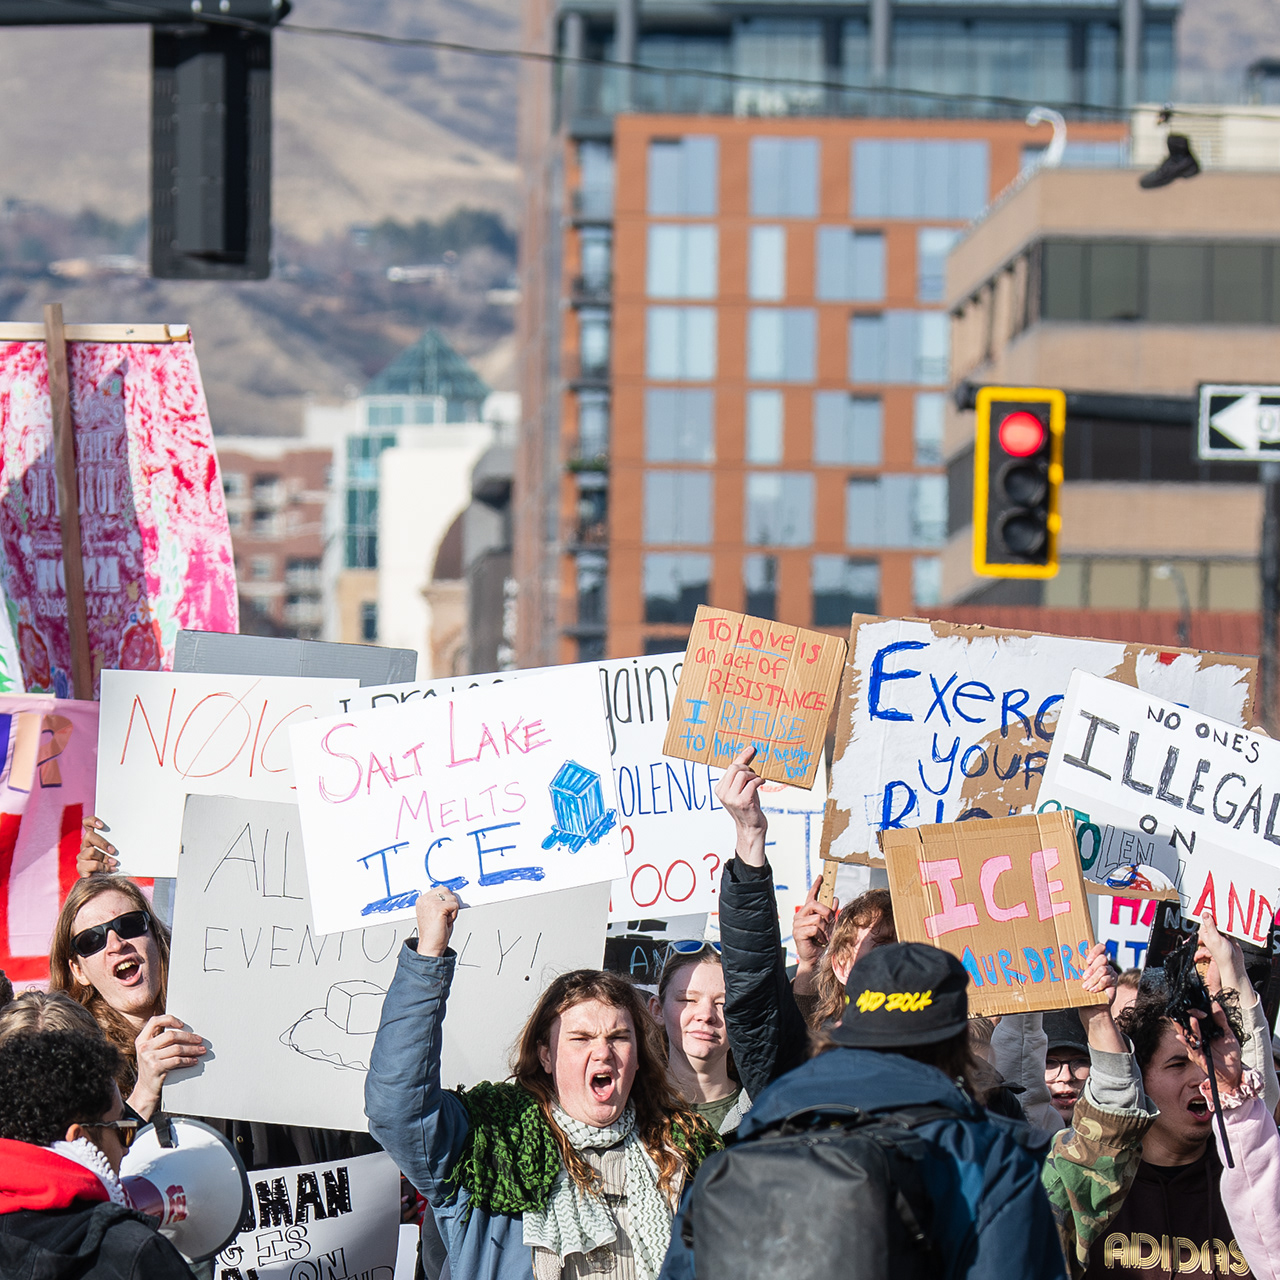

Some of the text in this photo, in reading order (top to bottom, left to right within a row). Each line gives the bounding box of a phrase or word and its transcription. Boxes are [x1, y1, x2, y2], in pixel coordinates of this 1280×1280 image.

[695, 647, 716, 664] an
[723, 652, 754, 671] act
[708, 669, 827, 711] RESISTANCE
[683, 699, 806, 740] I REFUSE
[1147, 705, 1259, 763] NO ONE'S
[679, 727, 706, 751] to
[714, 731, 745, 759] hate
[785, 762, 812, 778] bor
[1139, 814, 1196, 855] ON
[204, 822, 304, 900] ALL
[356, 821, 546, 916] ICE
[919, 847, 1072, 939] ICE
[256, 1224, 311, 1267] IS
[1104, 1232, 1251, 1277] ADIDAS
